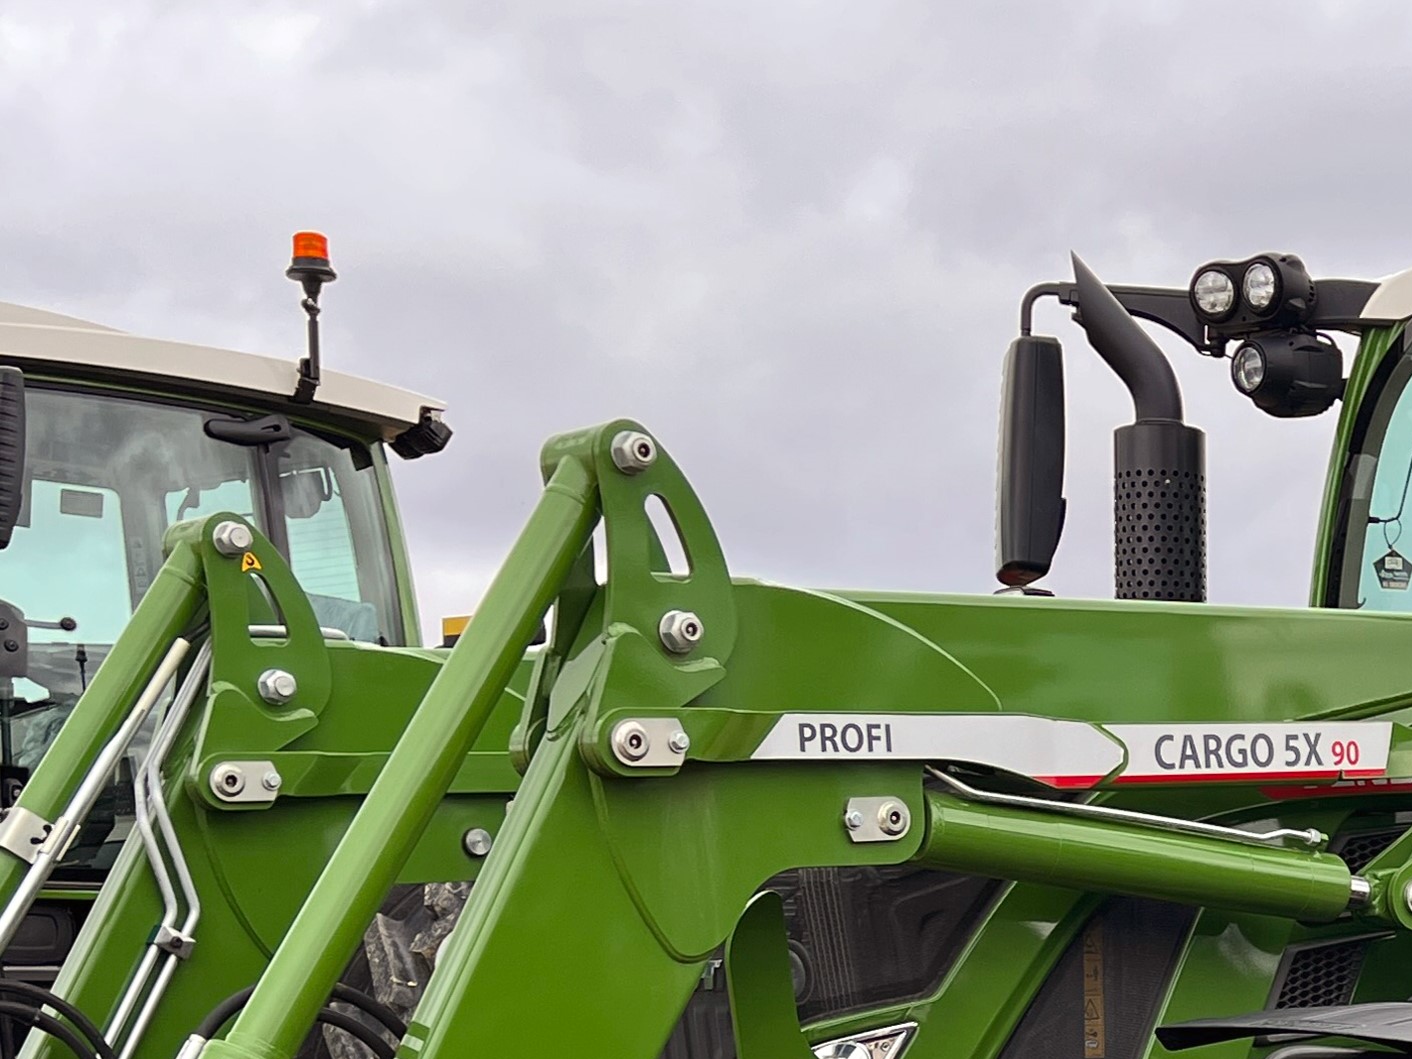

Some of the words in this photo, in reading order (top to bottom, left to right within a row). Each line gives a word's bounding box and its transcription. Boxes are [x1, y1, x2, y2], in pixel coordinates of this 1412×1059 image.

[799, 724, 892, 753] PROFI
[1155, 734, 1274, 771] CARGO
[1285, 733, 1323, 766] 5X
[1331, 741, 1361, 766] 90
